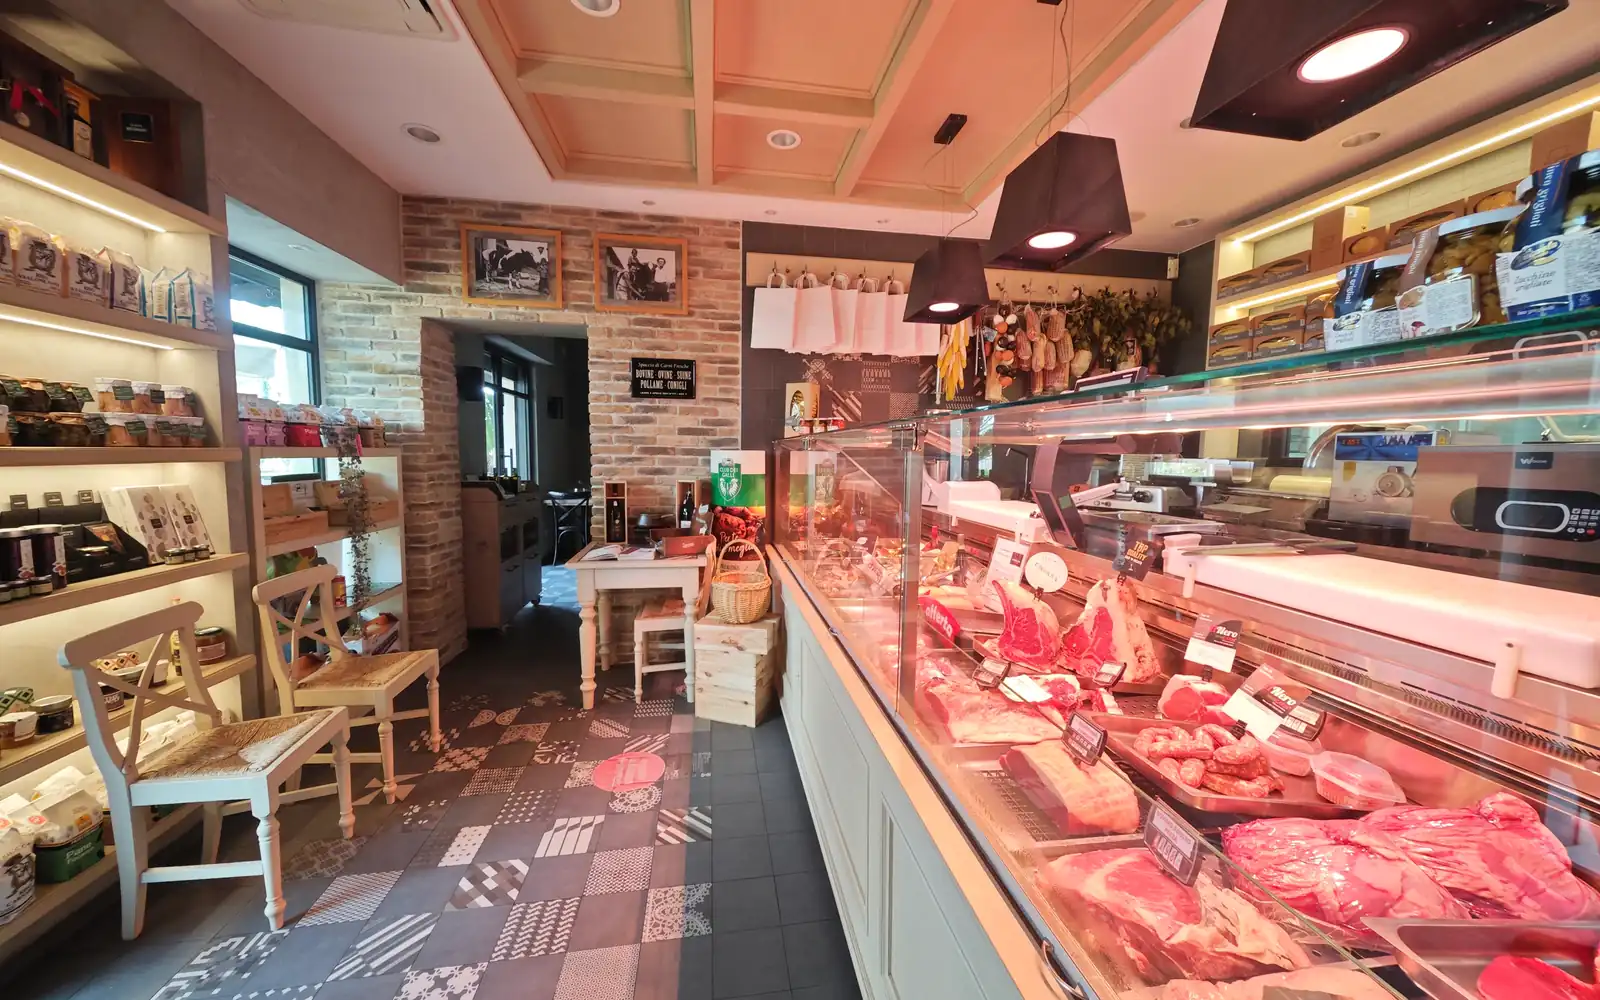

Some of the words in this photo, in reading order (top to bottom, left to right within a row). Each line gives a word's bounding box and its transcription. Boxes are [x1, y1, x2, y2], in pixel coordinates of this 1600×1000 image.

[1530, 187, 1550, 228] grigliati
[636, 369, 655, 379] BOVINE
[658, 370, 673, 380] OVINE
[677, 371, 692, 380] SUINE
[640, 380, 664, 389] POLLAME
[667, 380, 687, 390] CONIGLI
[720, 531, 730, 542] Per
[1126, 548, 1149, 561] QUALITY
[925, 603, 953, 638] offerta
